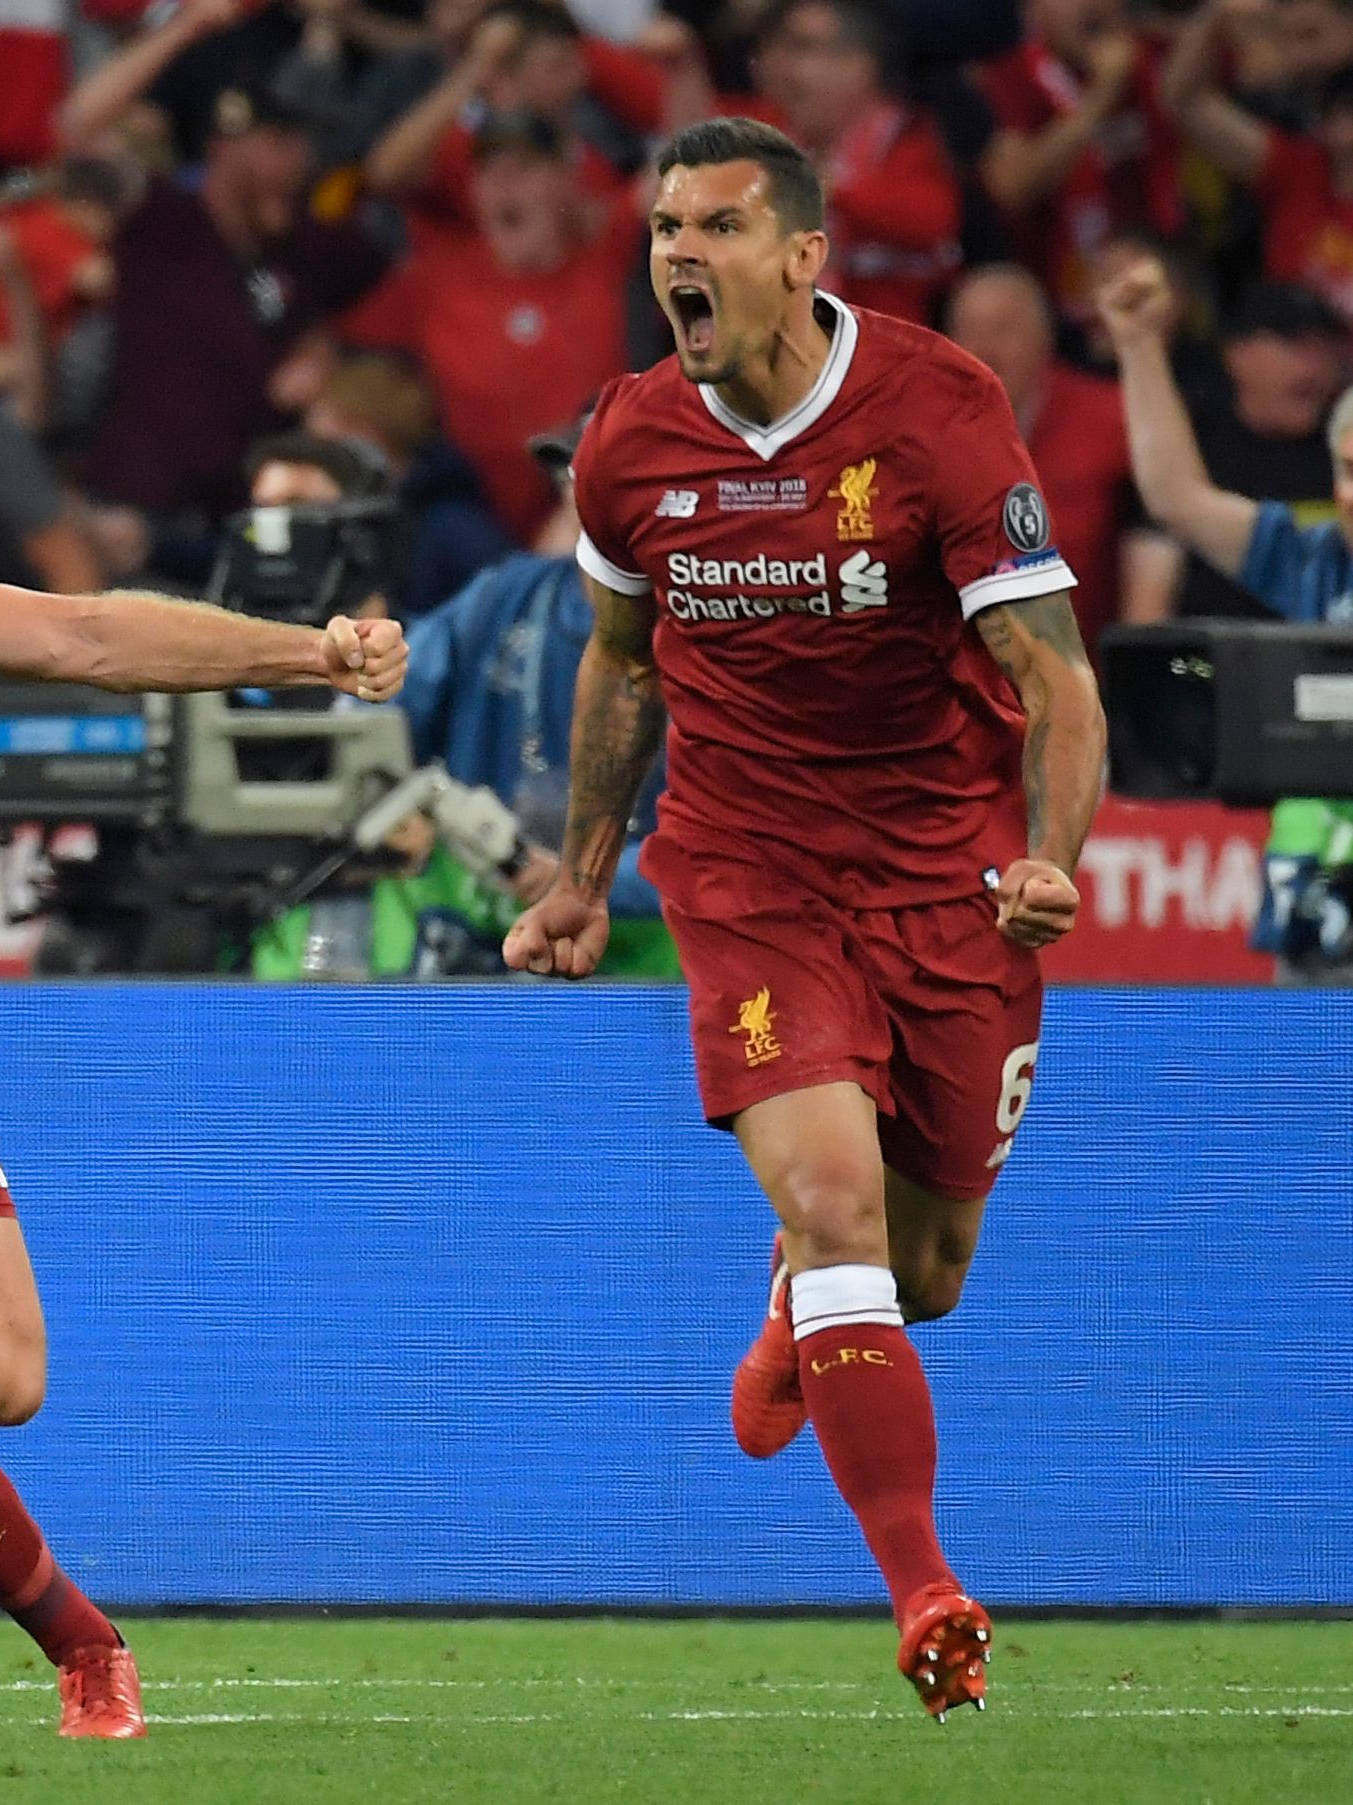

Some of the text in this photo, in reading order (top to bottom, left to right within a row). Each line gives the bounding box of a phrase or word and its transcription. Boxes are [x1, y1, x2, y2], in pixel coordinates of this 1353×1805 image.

[668, 553, 827, 586] Standard
[667, 590, 831, 620] Chartered
[745, 1036, 781, 1059] LFC
[996, 1042, 1040, 1134] 6
